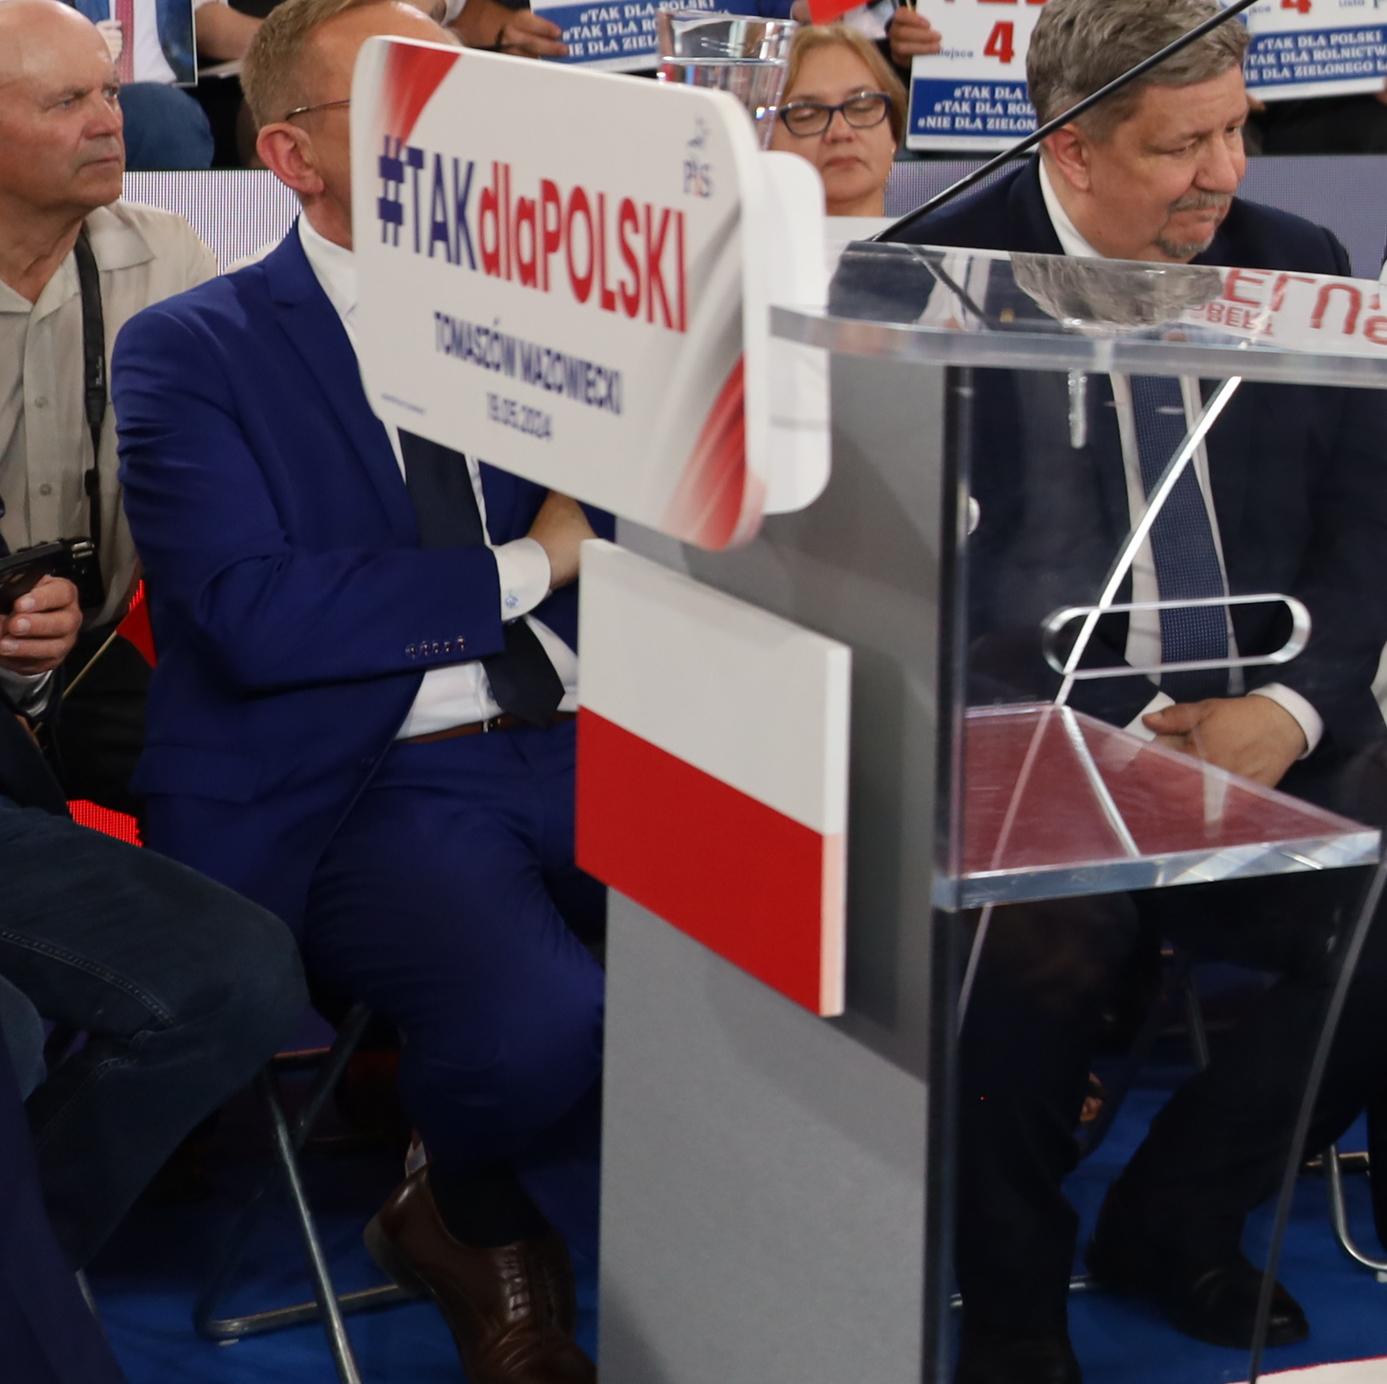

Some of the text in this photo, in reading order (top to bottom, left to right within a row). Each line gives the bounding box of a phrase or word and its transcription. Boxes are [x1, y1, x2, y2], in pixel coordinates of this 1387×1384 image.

[624, 2, 655, 19] DLA
[606, 19, 638, 36] DLA
[588, 38, 620, 55] DLA
[984, 21, 1015, 64] 4
[1298, 34, 1326, 49] DLA
[1330, 30, 1383, 46] POLSKI
[1247, 53, 1277, 67] TAK
[1280, 49, 1310, 64] DLA
[1263, 65, 1290, 80] DLA
[1294, 58, 1373, 78] ZIELONEGO
[994, 86, 1023, 101] DLA
[975, 101, 1004, 116] DLA
[954, 117, 983, 130] DLA
[376, 134, 687, 334] #TAKdlaPOLSKI
[434, 310, 622, 415] TOMASZÓW MAZOWIECKI
